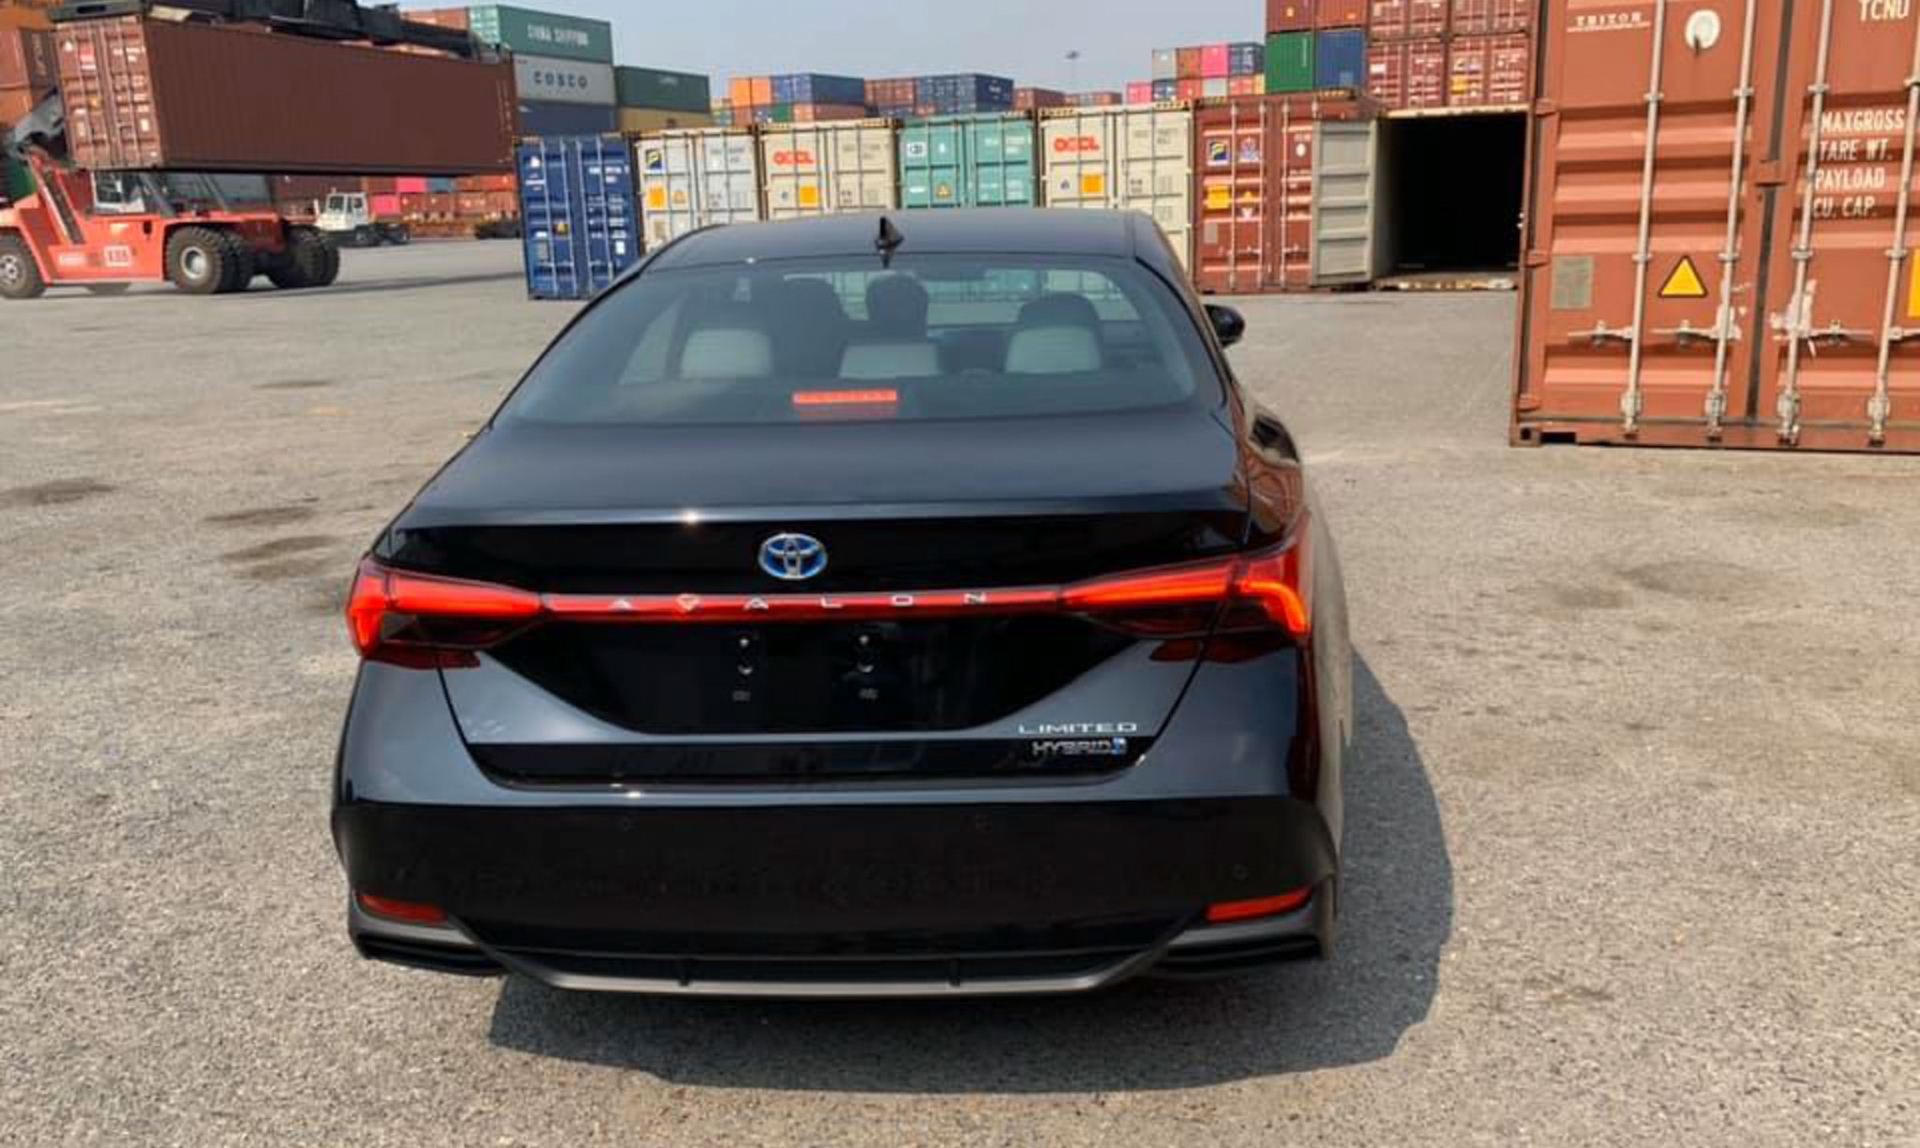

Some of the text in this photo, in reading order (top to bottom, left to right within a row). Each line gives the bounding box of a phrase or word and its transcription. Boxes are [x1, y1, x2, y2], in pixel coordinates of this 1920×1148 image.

[1576, 12, 1642, 27] TRITON
[1858, 0, 1911, 21] TCNU
[533, 70, 588, 88] COSCO
[1820, 109, 1905, 133] MAXGROSS
[1818, 140, 1859, 160] TARE
[1815, 167, 1885, 190] PAYLOAD
[609, 592, 987, 611] AVALON
[1018, 722, 1137, 735] LIMITED
[1032, 740, 1112, 755] HYBRID
